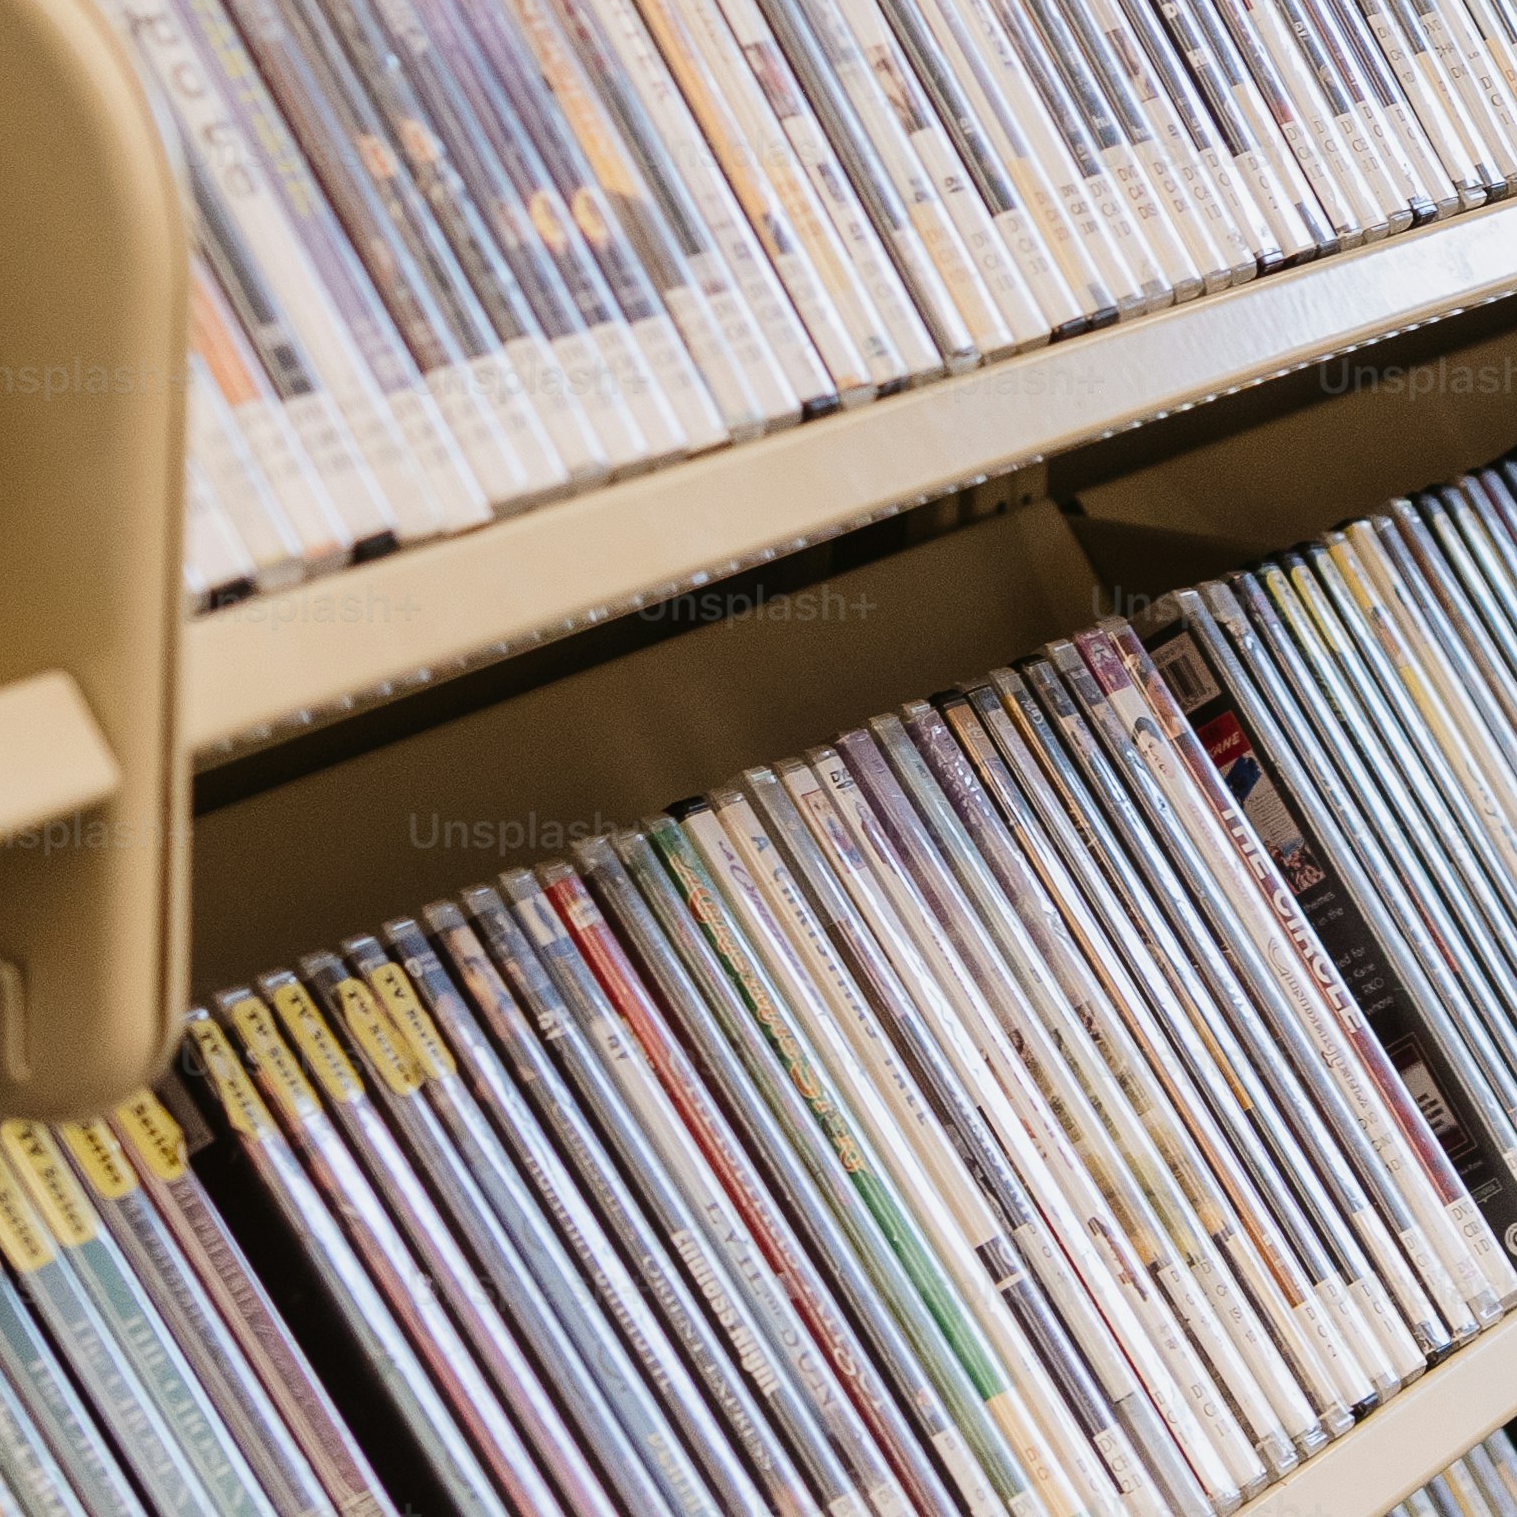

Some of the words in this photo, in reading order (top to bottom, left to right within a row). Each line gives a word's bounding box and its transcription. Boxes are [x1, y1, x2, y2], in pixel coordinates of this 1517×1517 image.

[749, 830, 771, 853] A
[1218, 806, 1272, 881] THE
[1264, 887, 1367, 1036] CIRCLE
[1327, 905, 1345, 920] the
[242, 1008, 270, 1042] TV
[285, 990, 314, 1026] TV
[380, 971, 407, 1003] TV
[403, 1007, 449, 1069] Series
[195, 1028, 227, 1066] TV
[367, 1021, 414, 1086] Series
[128, 1101, 181, 1172] Series
[13, 1126, 45, 1162] TV
[36, 1164, 90, 1237] Series
[667, 1225, 743, 1329] Endless
[724, 1323, 784, 1399] Night
[637, 1252, 708, 1353] ORIENT
[701, 1360, 780, 1473] EXPRESS
